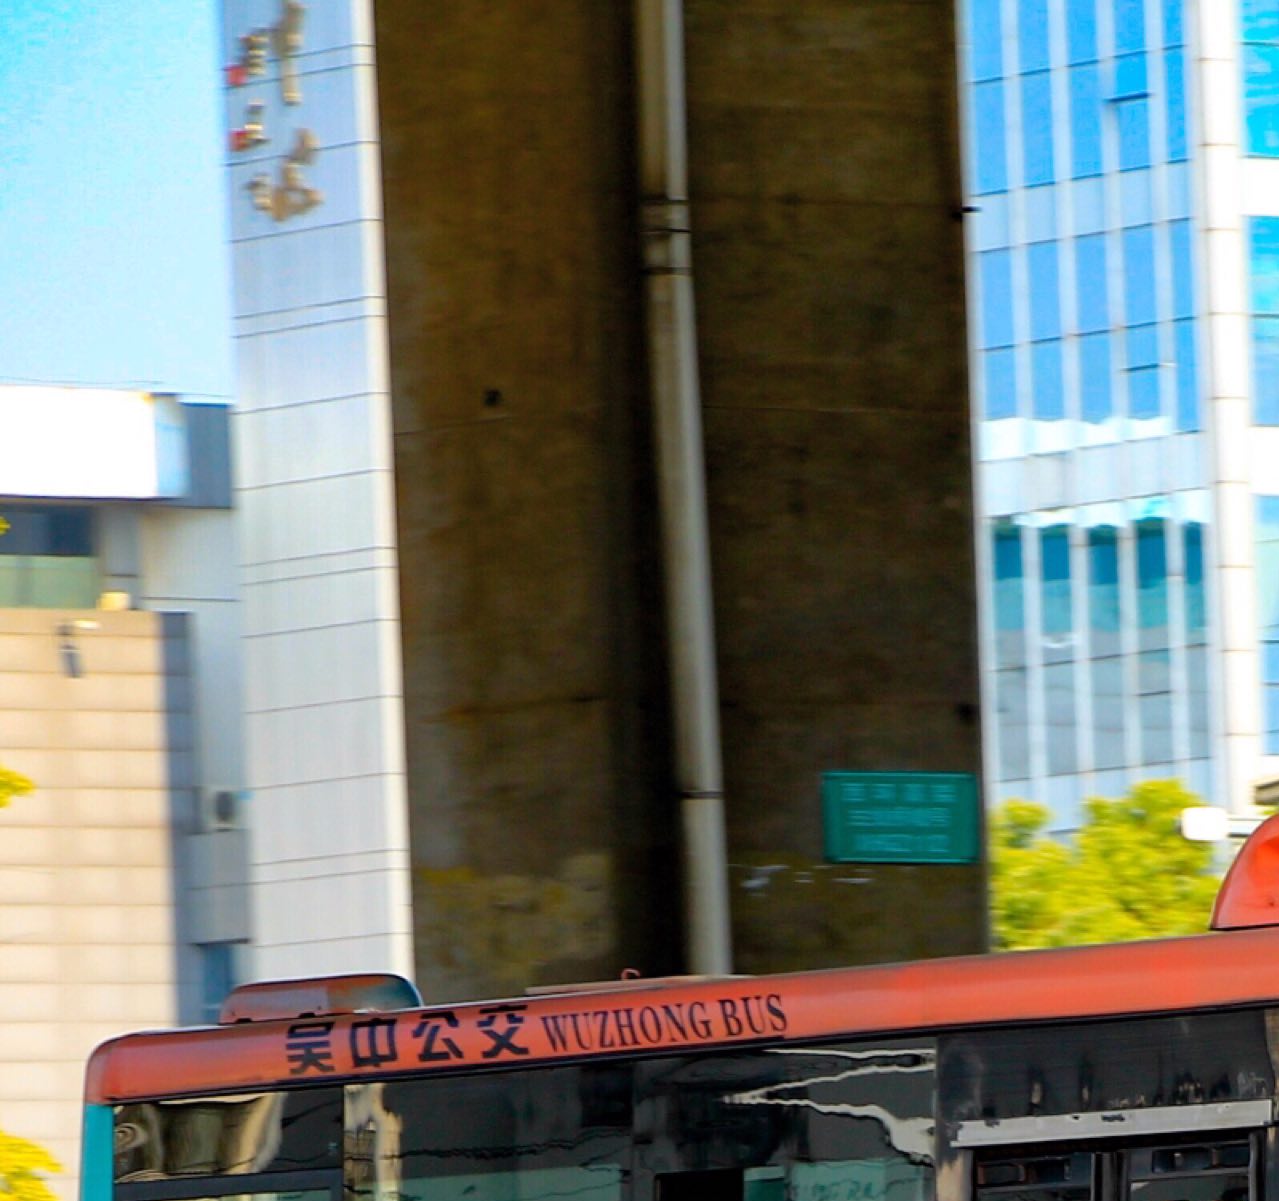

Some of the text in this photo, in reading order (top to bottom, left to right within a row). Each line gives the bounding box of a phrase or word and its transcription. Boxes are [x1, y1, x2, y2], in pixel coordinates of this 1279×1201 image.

[285, 1006, 530, 1074] 吴中公交
[540, 993, 788, 1052] WUZHONG BUS
